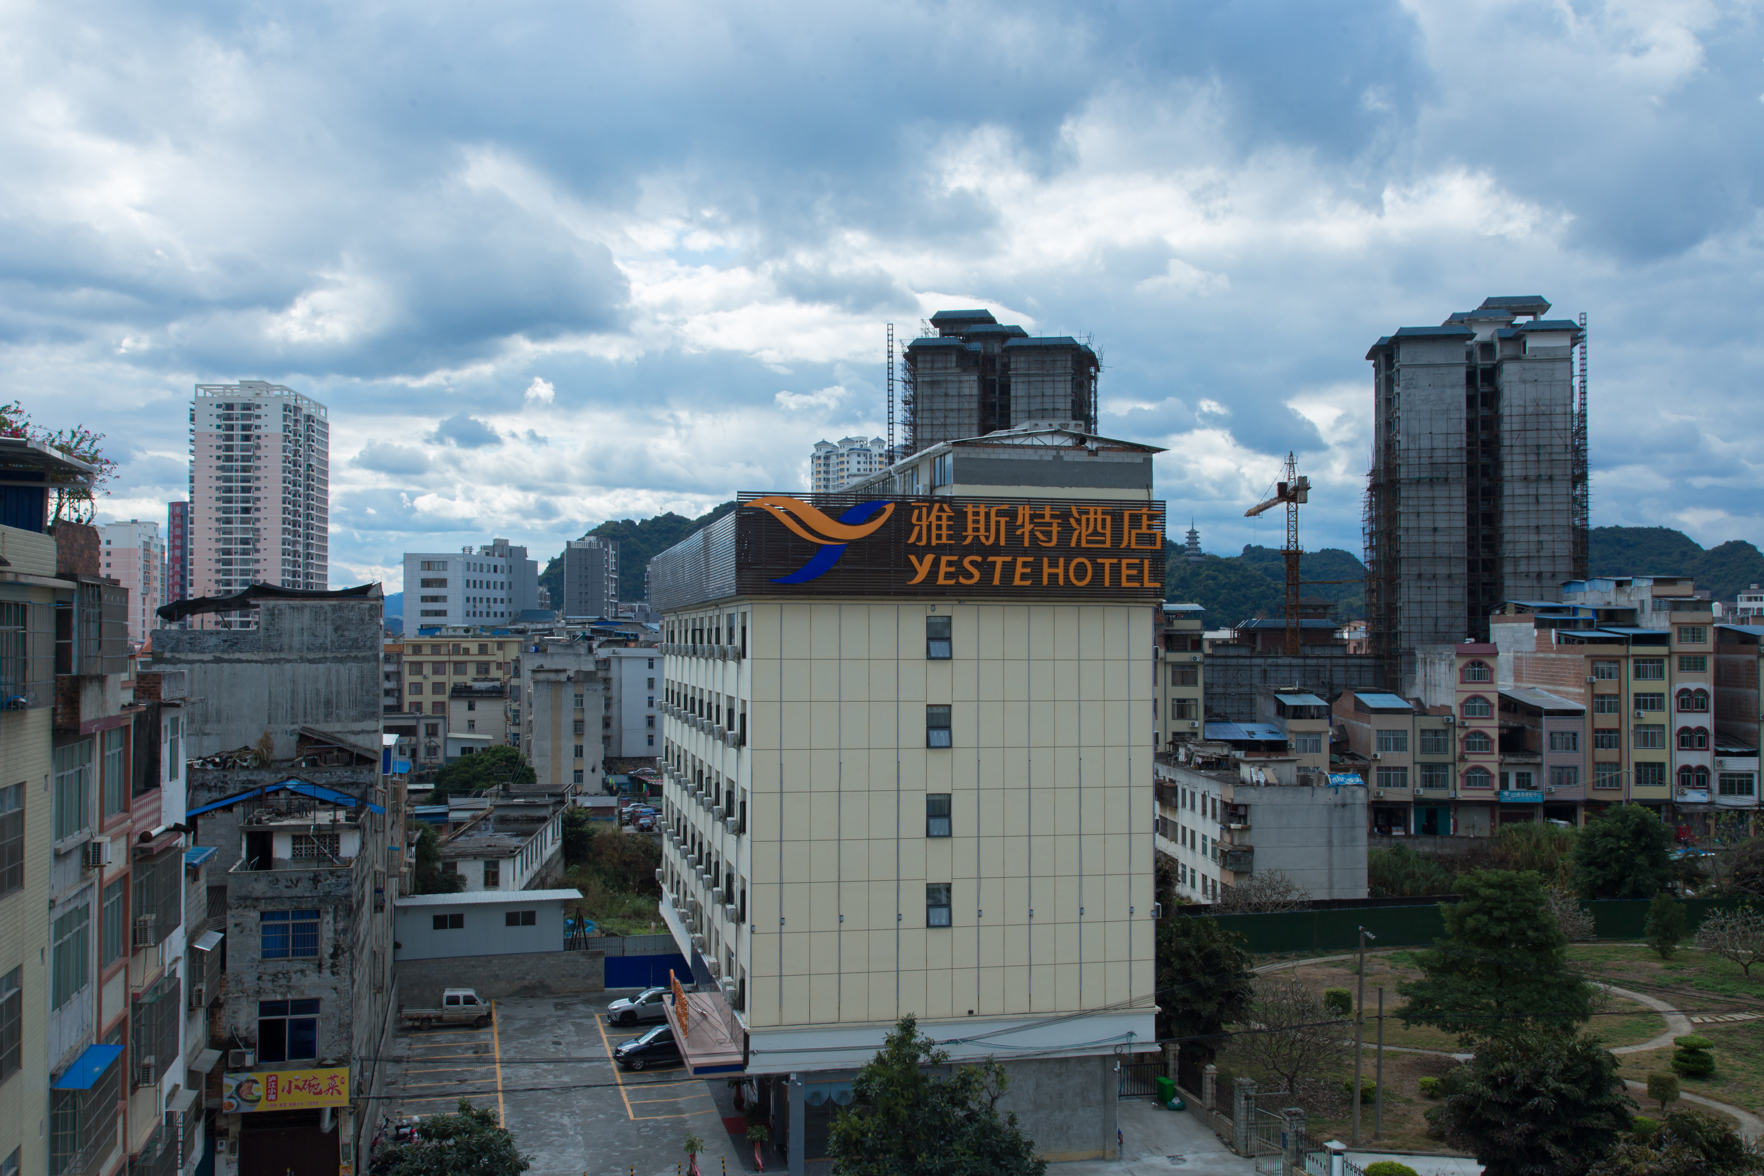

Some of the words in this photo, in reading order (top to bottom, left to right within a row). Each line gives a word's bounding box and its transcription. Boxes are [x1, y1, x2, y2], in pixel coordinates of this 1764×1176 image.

[907, 502, 1162, 550] 雅斯特酒店
[907, 554, 1035, 586] YESTE
[1043, 557, 1161, 587] HOTEL
[281, 1073, 343, 1097] 小碗菜
